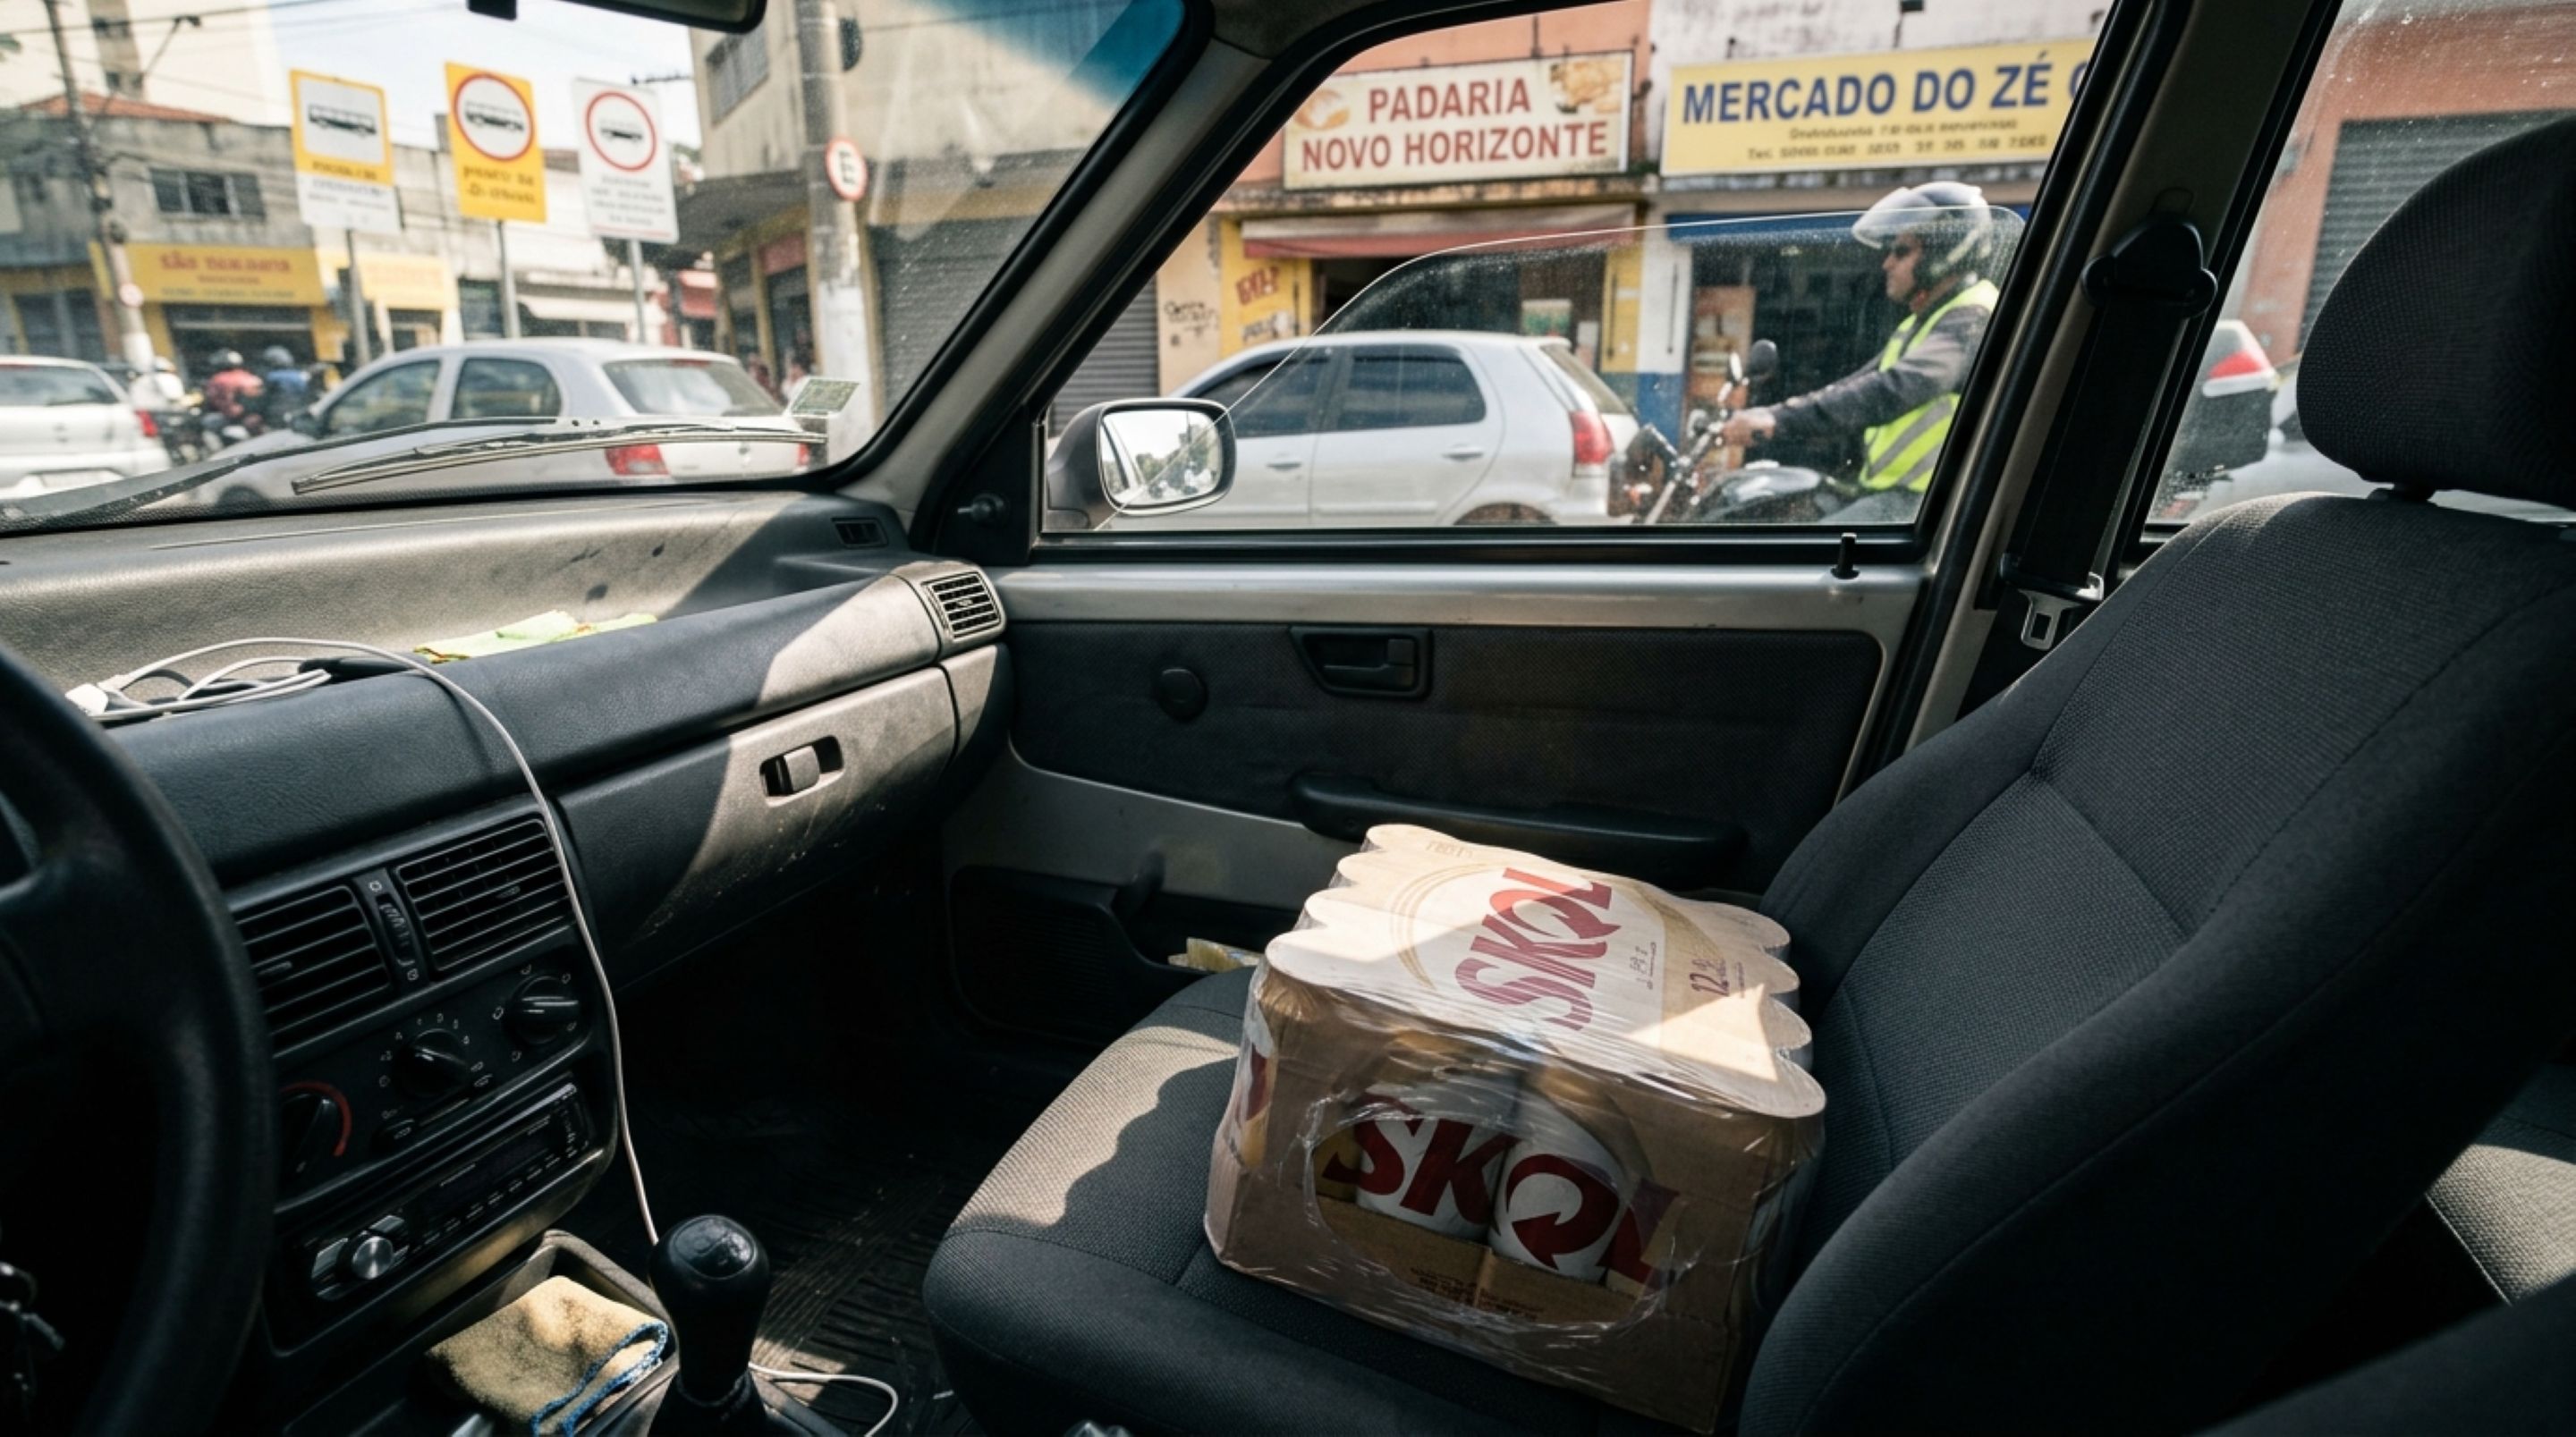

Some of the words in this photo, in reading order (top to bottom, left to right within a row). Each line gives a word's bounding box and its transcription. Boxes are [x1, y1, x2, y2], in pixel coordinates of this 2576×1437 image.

[1368, 78, 1531, 123] PADARIA
[1682, 72, 1896, 124] MERCADO
[1912, 68, 1976, 114] DO
[1990, 50, 2053, 109] ZÉ
[1301, 134, 1392, 173] NOVO
[1403, 121, 1608, 166] HORIZONTE
[1455, 866, 1623, 1031] SKOL
[1321, 1091, 1681, 1298] SKOL
